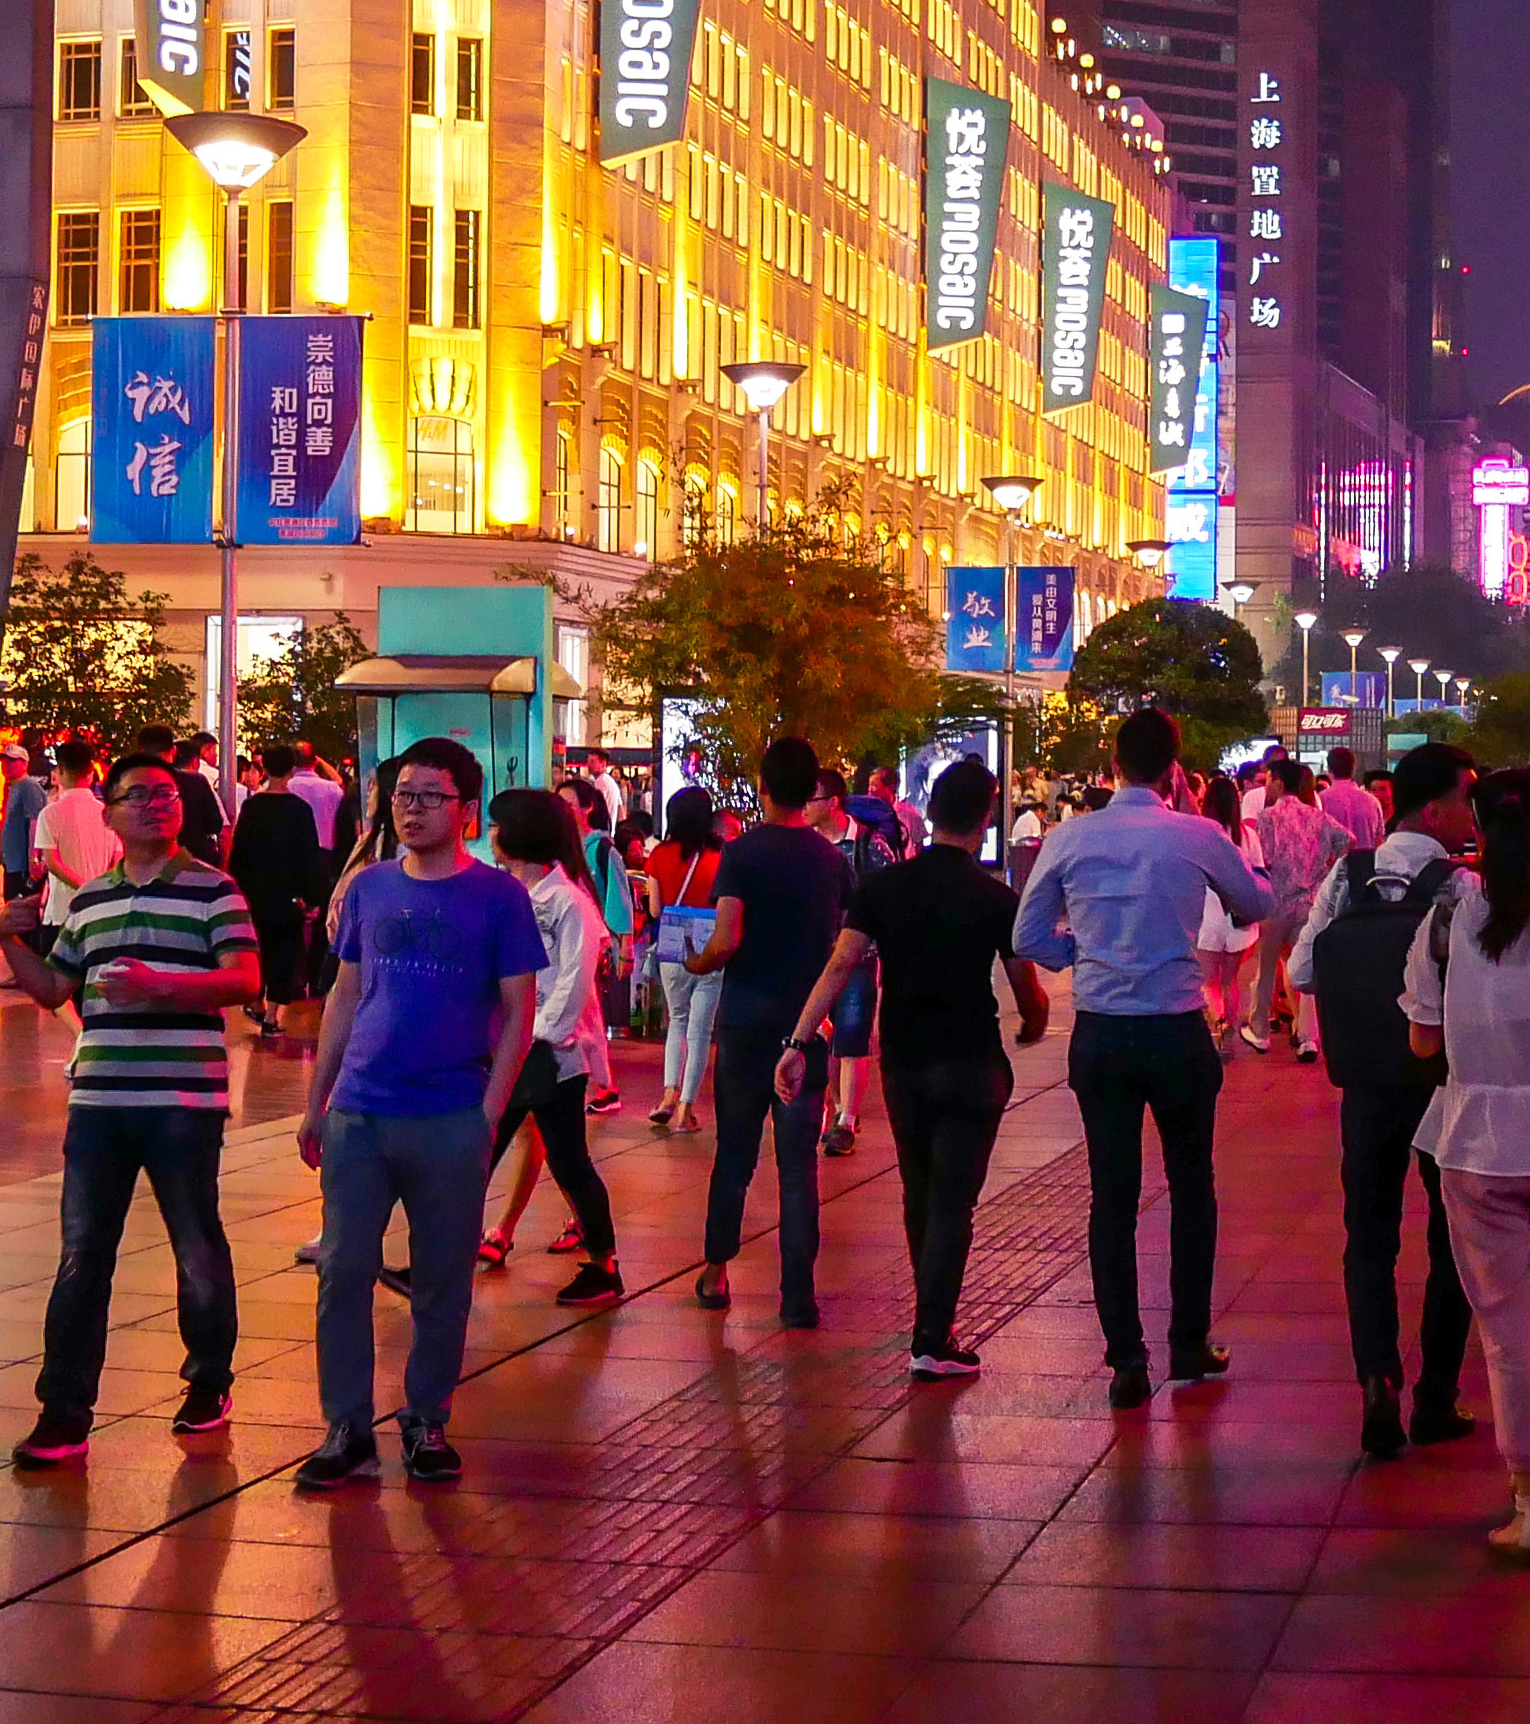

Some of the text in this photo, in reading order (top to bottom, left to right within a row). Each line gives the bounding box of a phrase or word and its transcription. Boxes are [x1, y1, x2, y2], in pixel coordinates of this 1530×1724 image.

[1250, 71, 1282, 329] 上海置地广场
[936, 202, 981, 330] mosaic
[306, 333, 335, 457] 崇德向善
[1050, 287, 1090, 396] mosaic
[269, 386, 298, 508] 和谐宜居
[1301, 712, 1348, 730] 可口可乐
